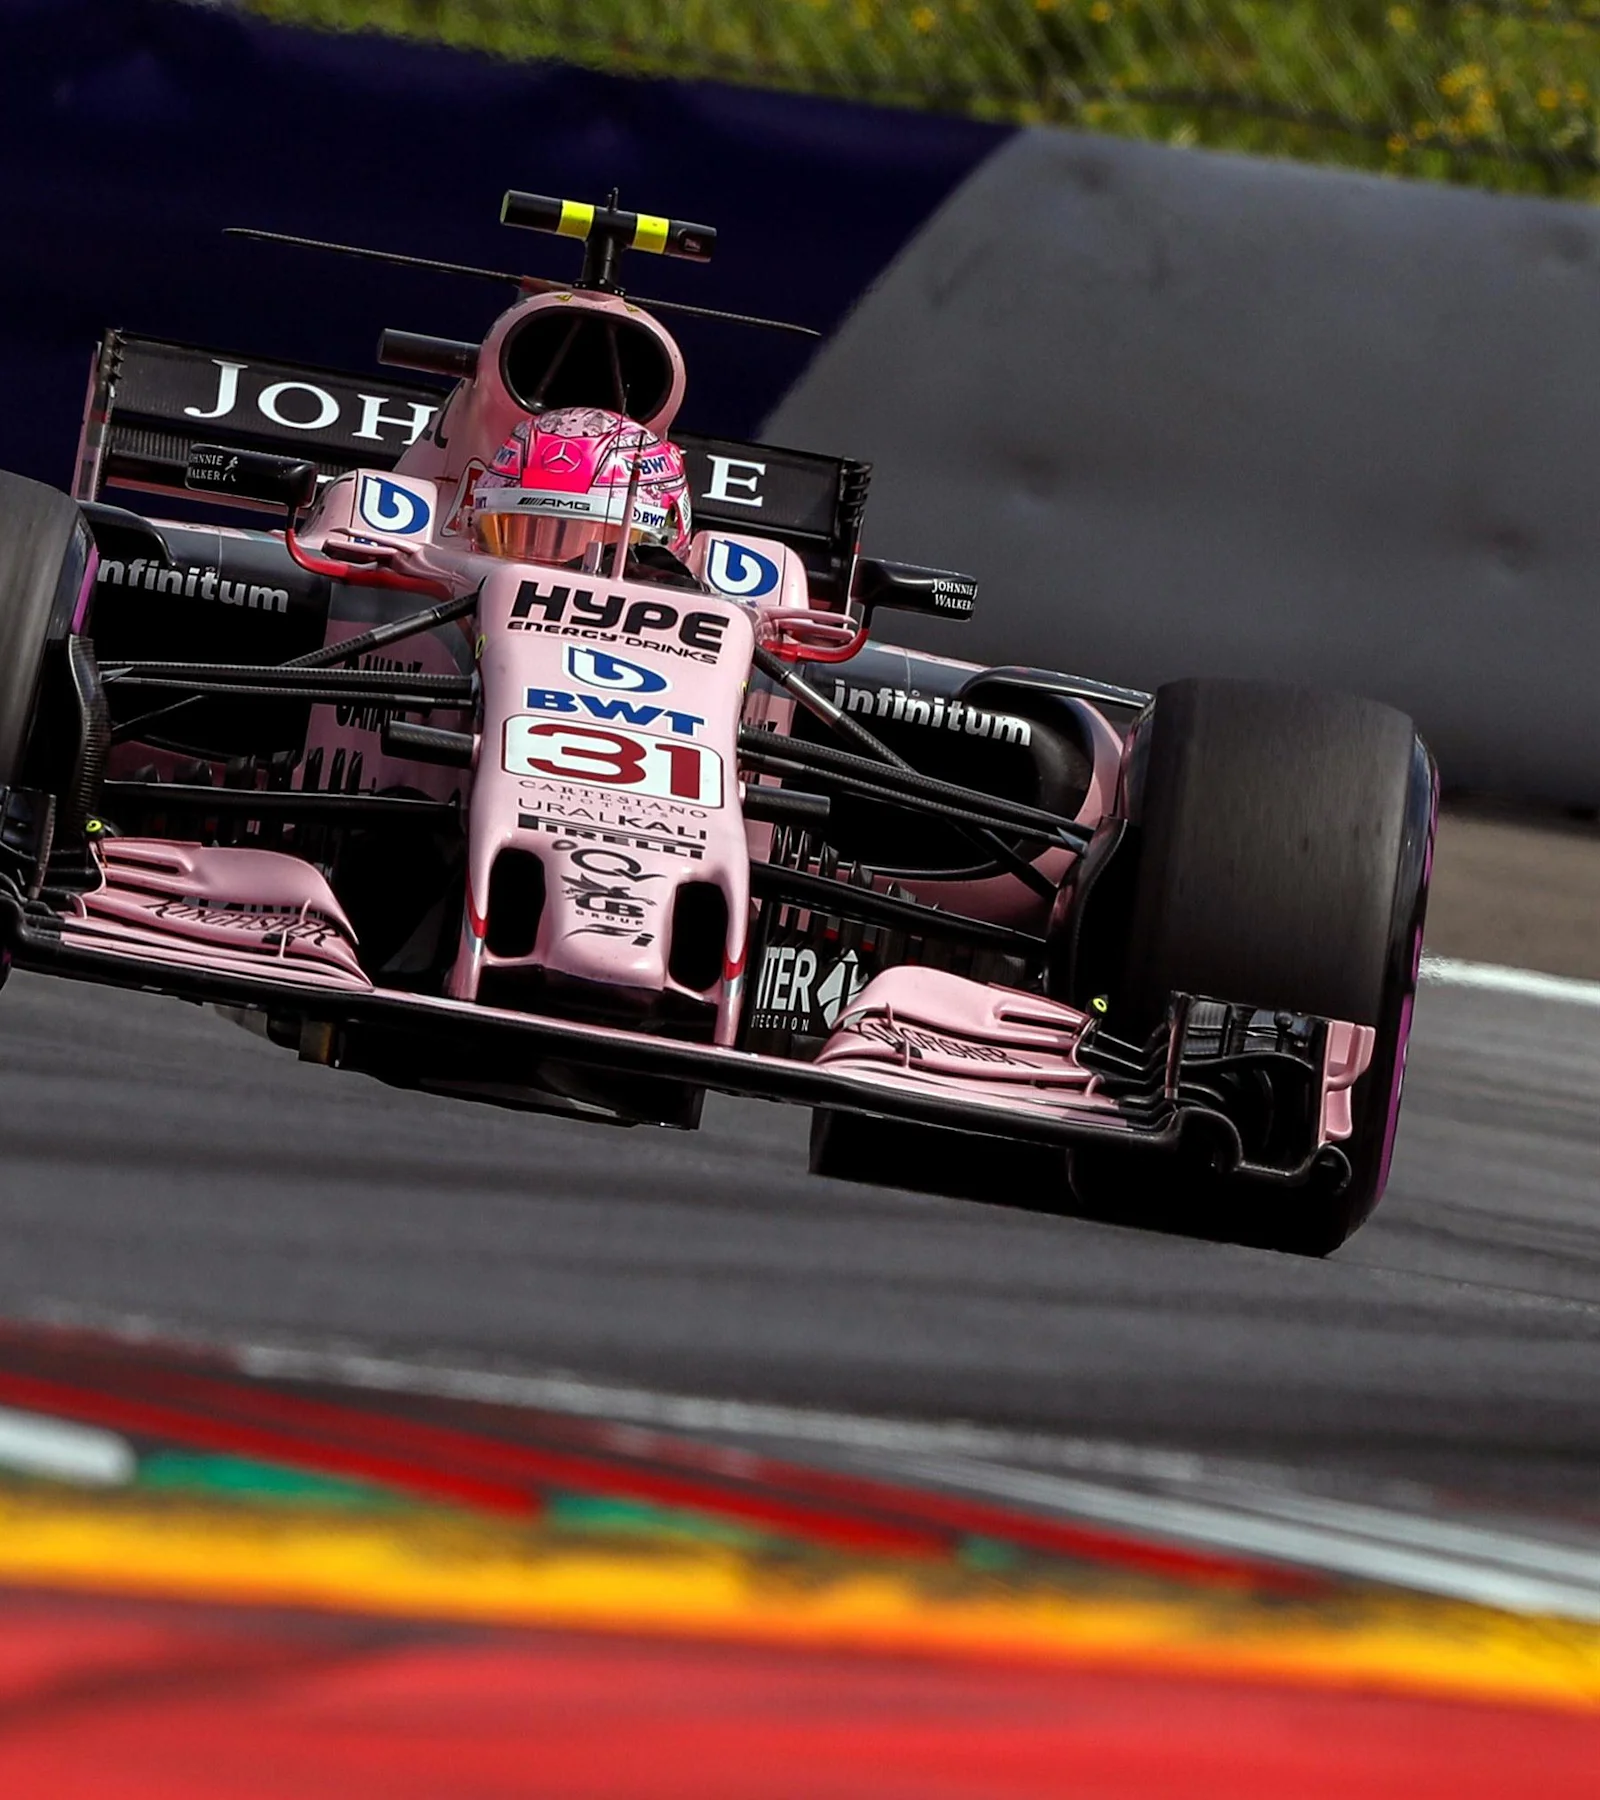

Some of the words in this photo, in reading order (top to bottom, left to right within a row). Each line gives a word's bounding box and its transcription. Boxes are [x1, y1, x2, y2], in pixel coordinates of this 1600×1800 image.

[641, 456, 670, 475] BWT
[542, 499, 590, 512] AMG
[97, 558, 290, 613] nfinitum
[932, 579, 974, 596] JOHNNIE
[935, 594, 974, 611] WALKER
[510, 580, 730, 654] HYPE
[624, 637, 718, 666] DRINKS
[527, 687, 705, 736] BWT
[833, 679, 1031, 747] infinitum
[525, 721, 701, 801] 31
[518, 780, 708, 819] CARTESIANO
[518, 798, 707, 841] URALKALI
[518, 813, 706, 861] PIRELLI
